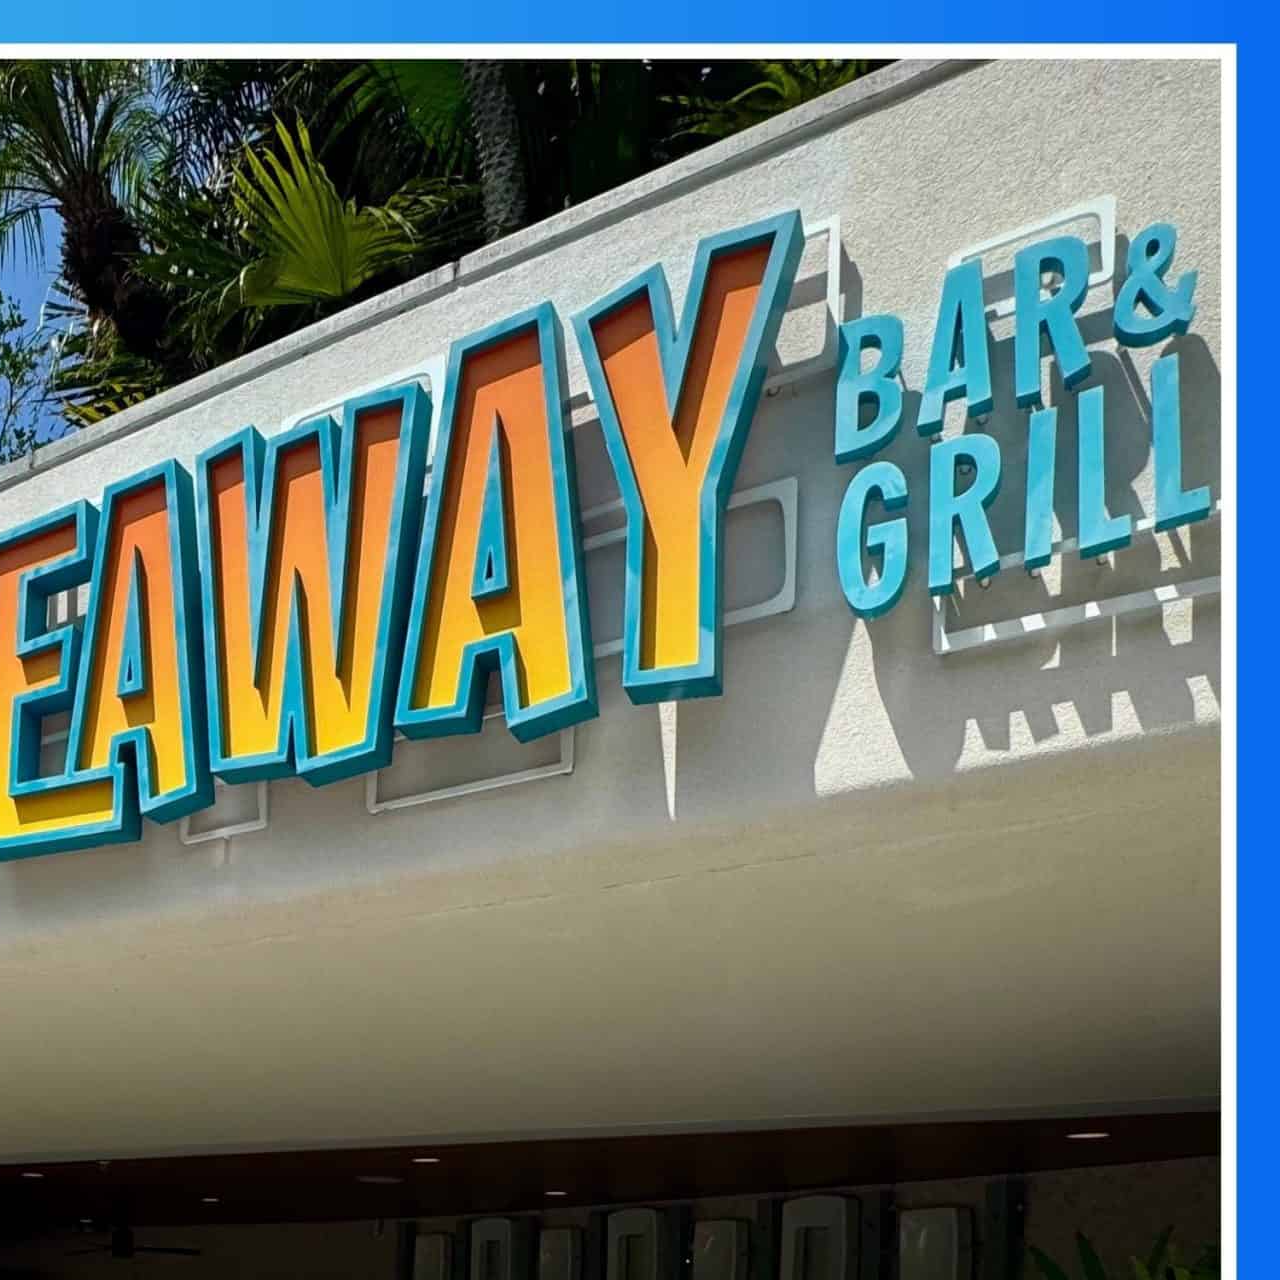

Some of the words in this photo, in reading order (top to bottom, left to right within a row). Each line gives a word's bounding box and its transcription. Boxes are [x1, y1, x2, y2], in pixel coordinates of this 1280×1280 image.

[834, 235, 1092, 464] BAR
[1113, 222, 1198, 348] &
[836, 352, 1211, 619] GRILL
